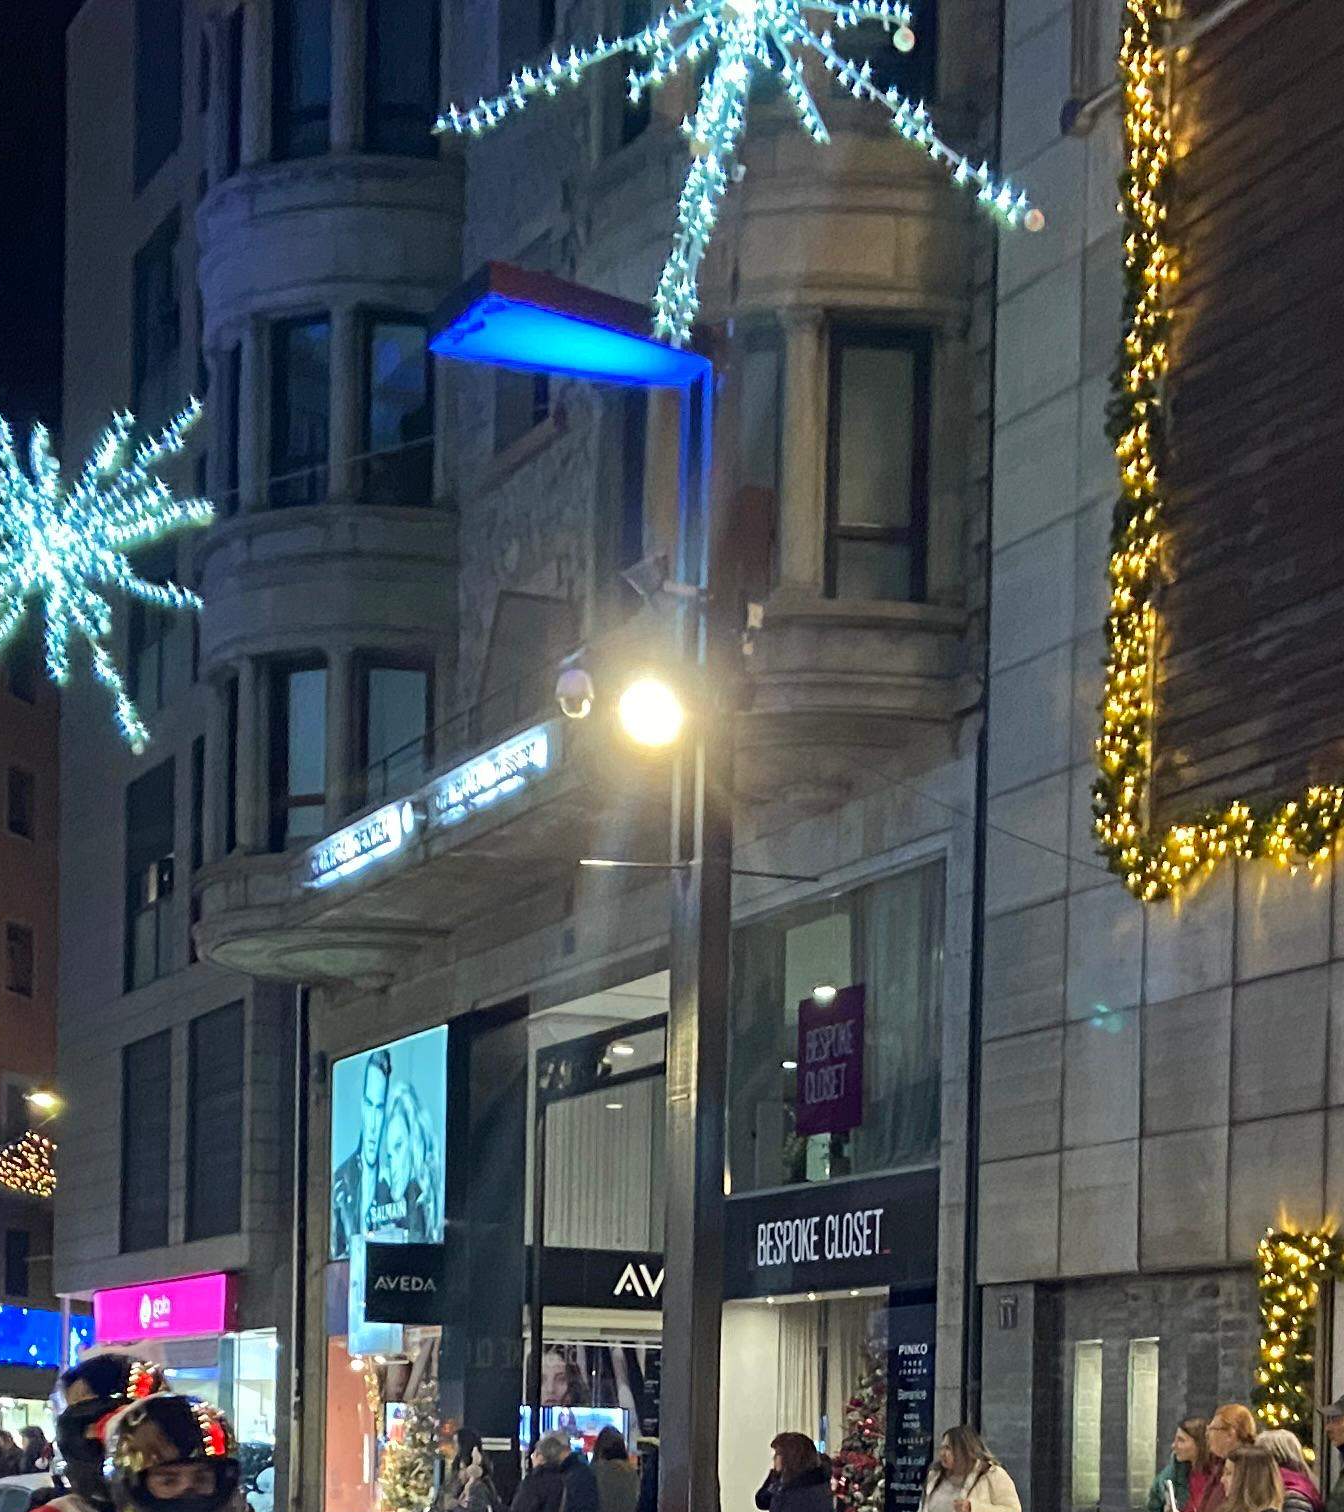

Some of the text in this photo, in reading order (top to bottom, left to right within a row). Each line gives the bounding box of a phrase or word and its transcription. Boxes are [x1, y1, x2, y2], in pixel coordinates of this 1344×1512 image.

[806, 1020, 854, 1063] BESPOKE
[805, 1063, 847, 1104] CLOSET
[756, 1216, 820, 1267] BESPOKE
[374, 1275, 436, 1293] AVEDA
[898, 1343, 928, 1355] PINKO
